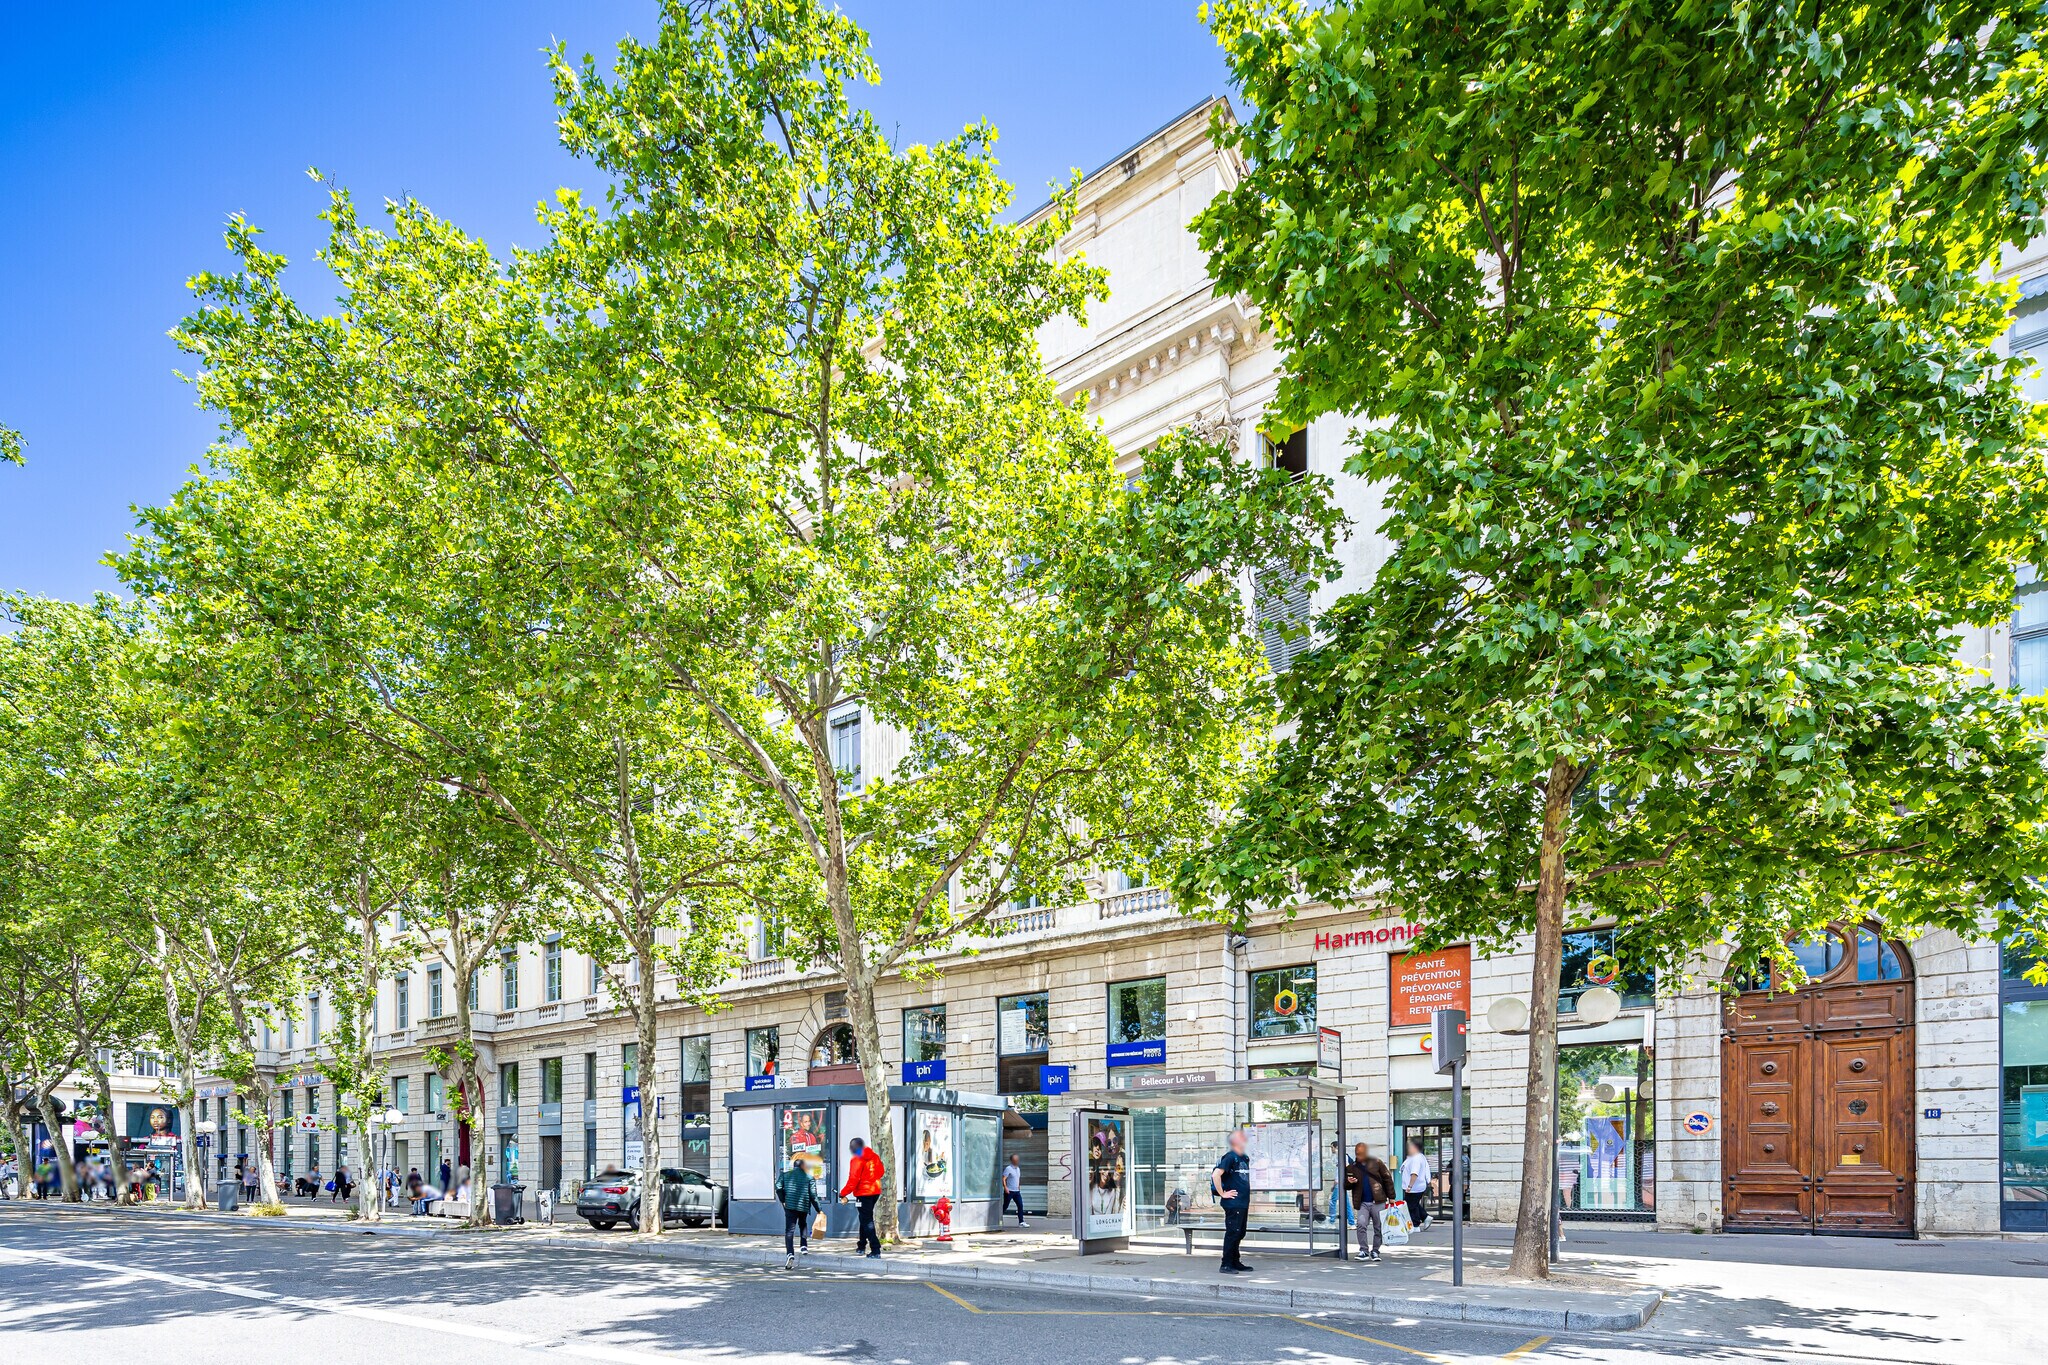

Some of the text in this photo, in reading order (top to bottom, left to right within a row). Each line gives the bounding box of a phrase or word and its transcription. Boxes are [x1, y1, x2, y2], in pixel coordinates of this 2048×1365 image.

[1315, 923, 1424, 950] Harmonie
[1415, 958, 1446, 970] SANTÉ
[1401, 969, 1461, 982] PRÉVENTION
[1400, 981, 1462, 994] PRÉVOYANCE
[1409, 992, 1453, 1004] ÉPARGNE
[1140, 1074, 1206, 1086] Bellecour Le Viste
[1928, 1110, 1938, 1118] 18
